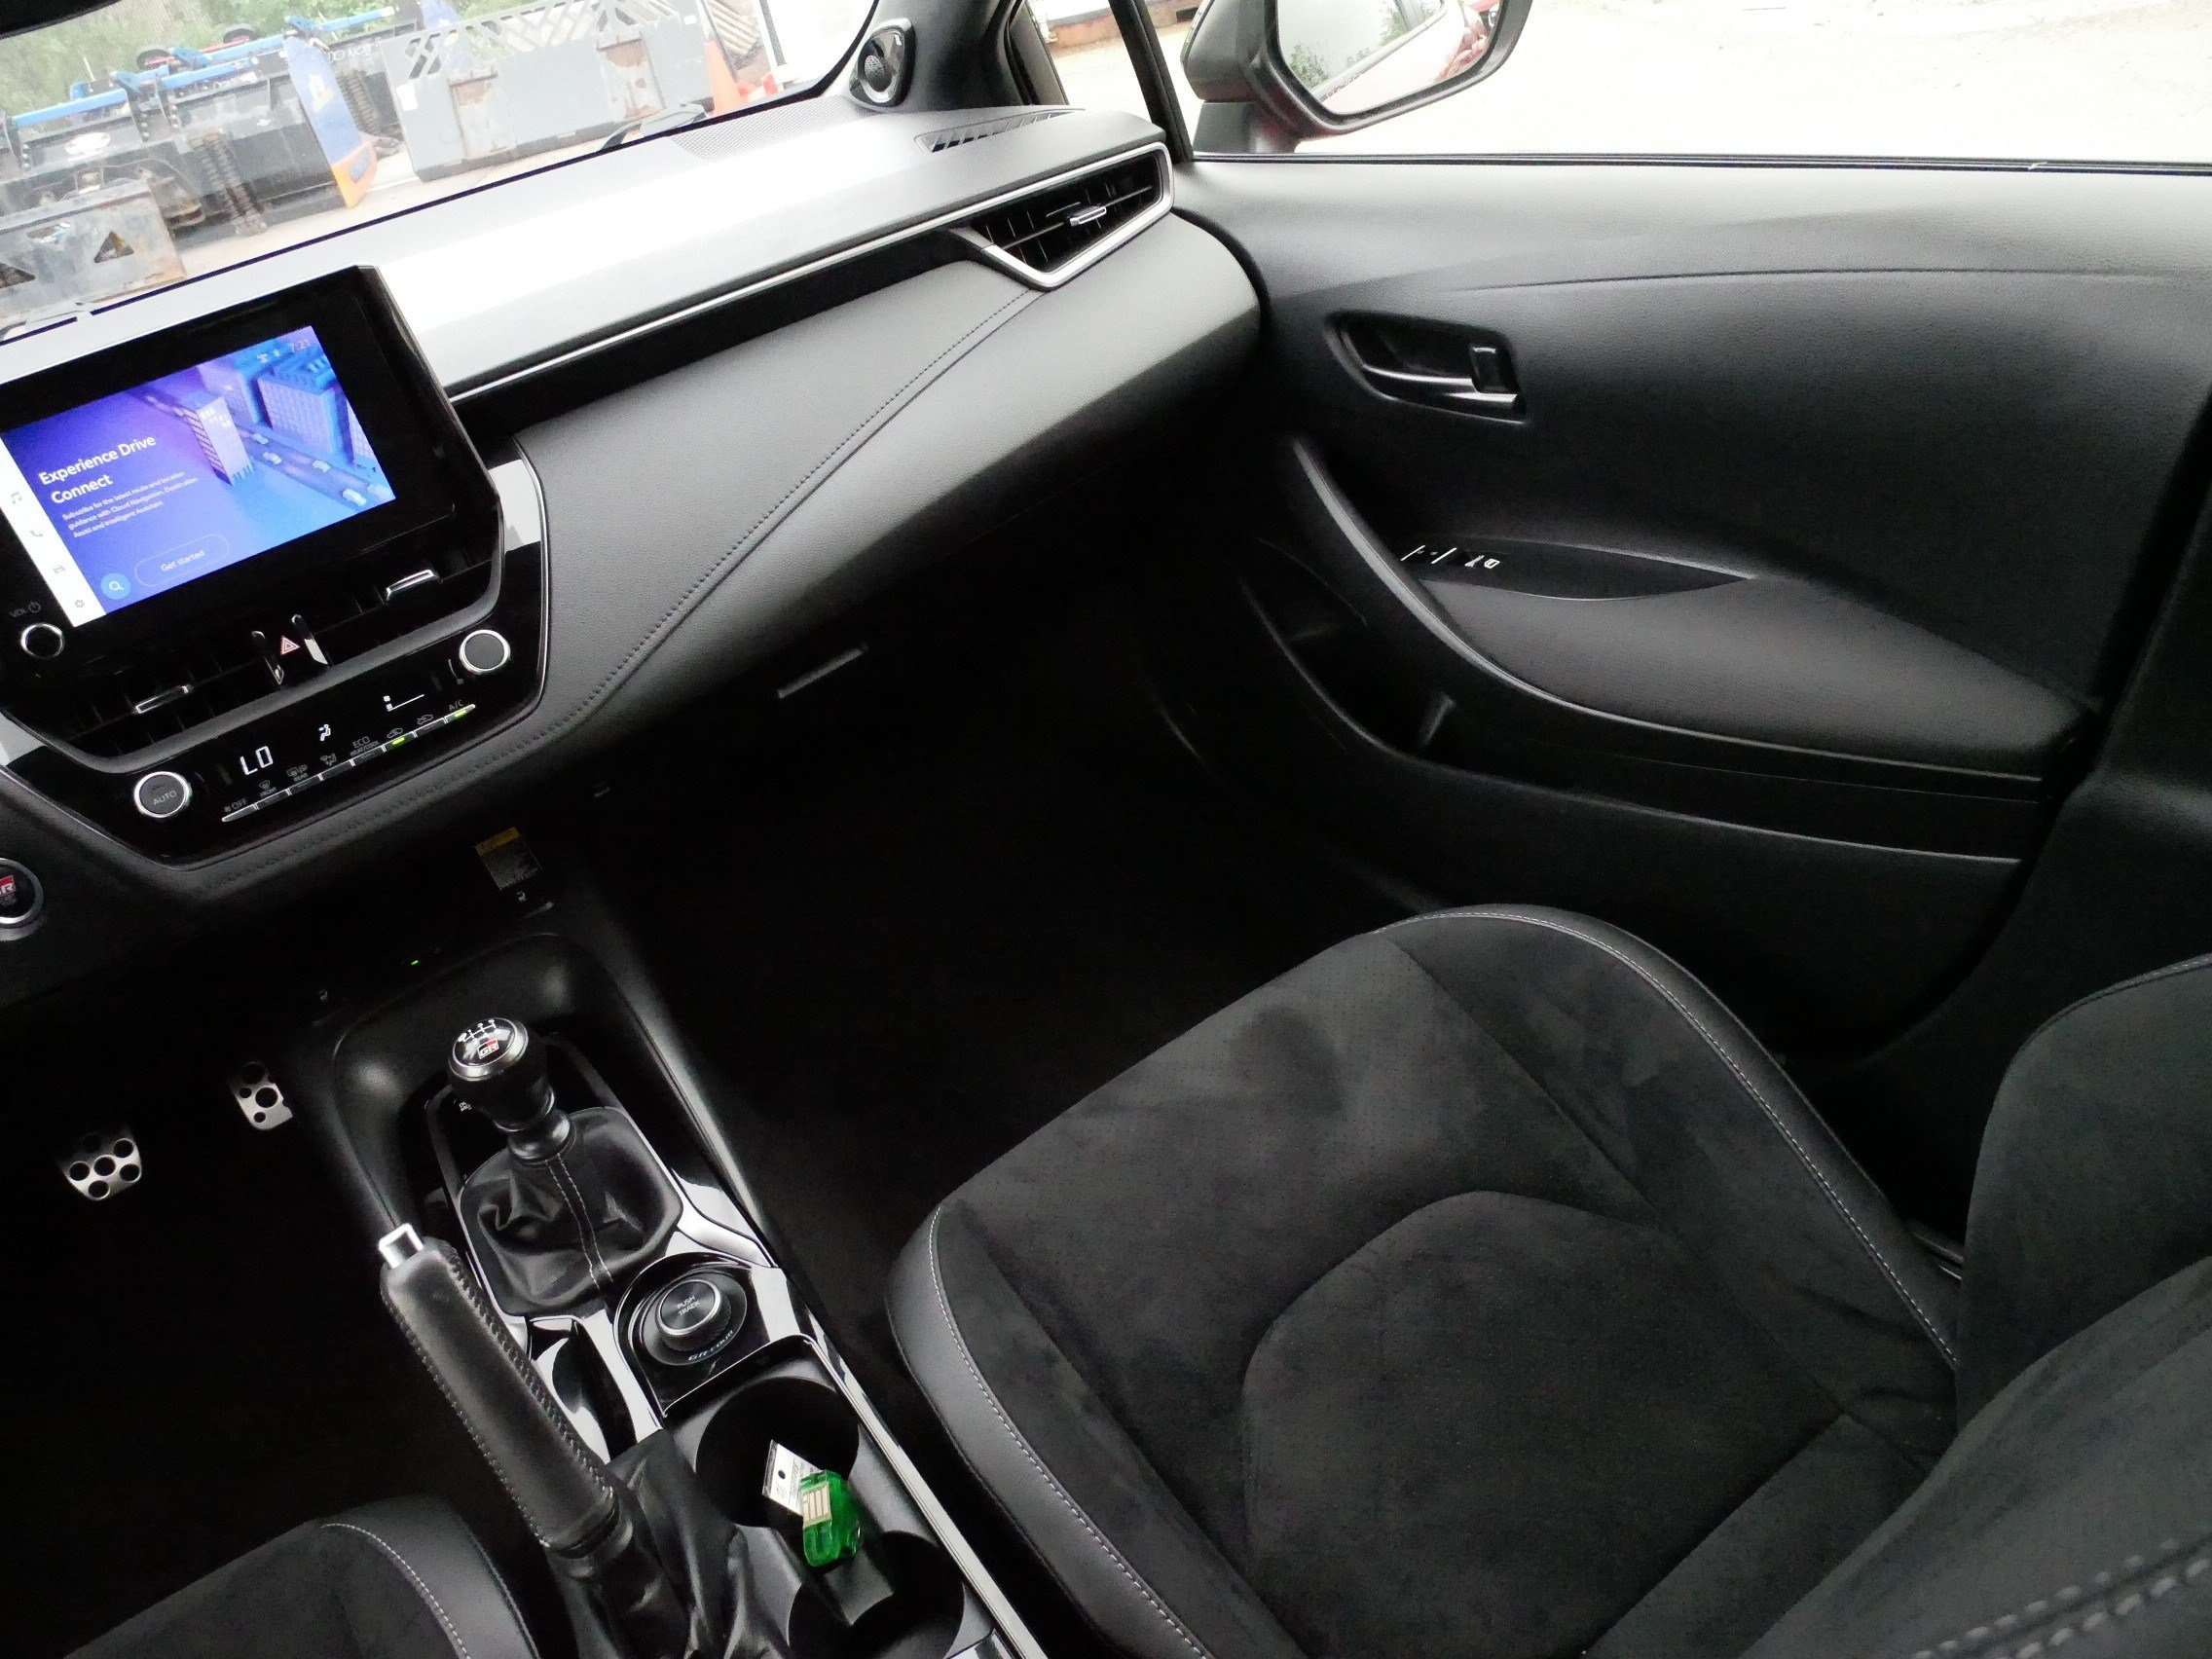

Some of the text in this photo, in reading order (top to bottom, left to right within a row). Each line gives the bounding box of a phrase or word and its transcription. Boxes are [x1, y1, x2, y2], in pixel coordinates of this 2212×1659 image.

[38, 436, 157, 486] Experience Drive
[51, 474, 113, 504] Connect
[62, 505, 93, 521] Subscribe
[161, 471, 186, 484] location
[68, 515, 97, 531] guidance
[96, 509, 111, 518] with
[111, 500, 130, 512] Cloud
[161, 550, 205, 571] Get started
[449, 700, 464, 712] A/C
[352, 736, 370, 750] ECO
[240, 746, 274, 775] LO
[153, 790, 177, 805] AUTO
[231, 797, 248, 810] OFF
[677, 1295, 695, 1309] PUSH
[678, 1300, 700, 1316] TRACK
